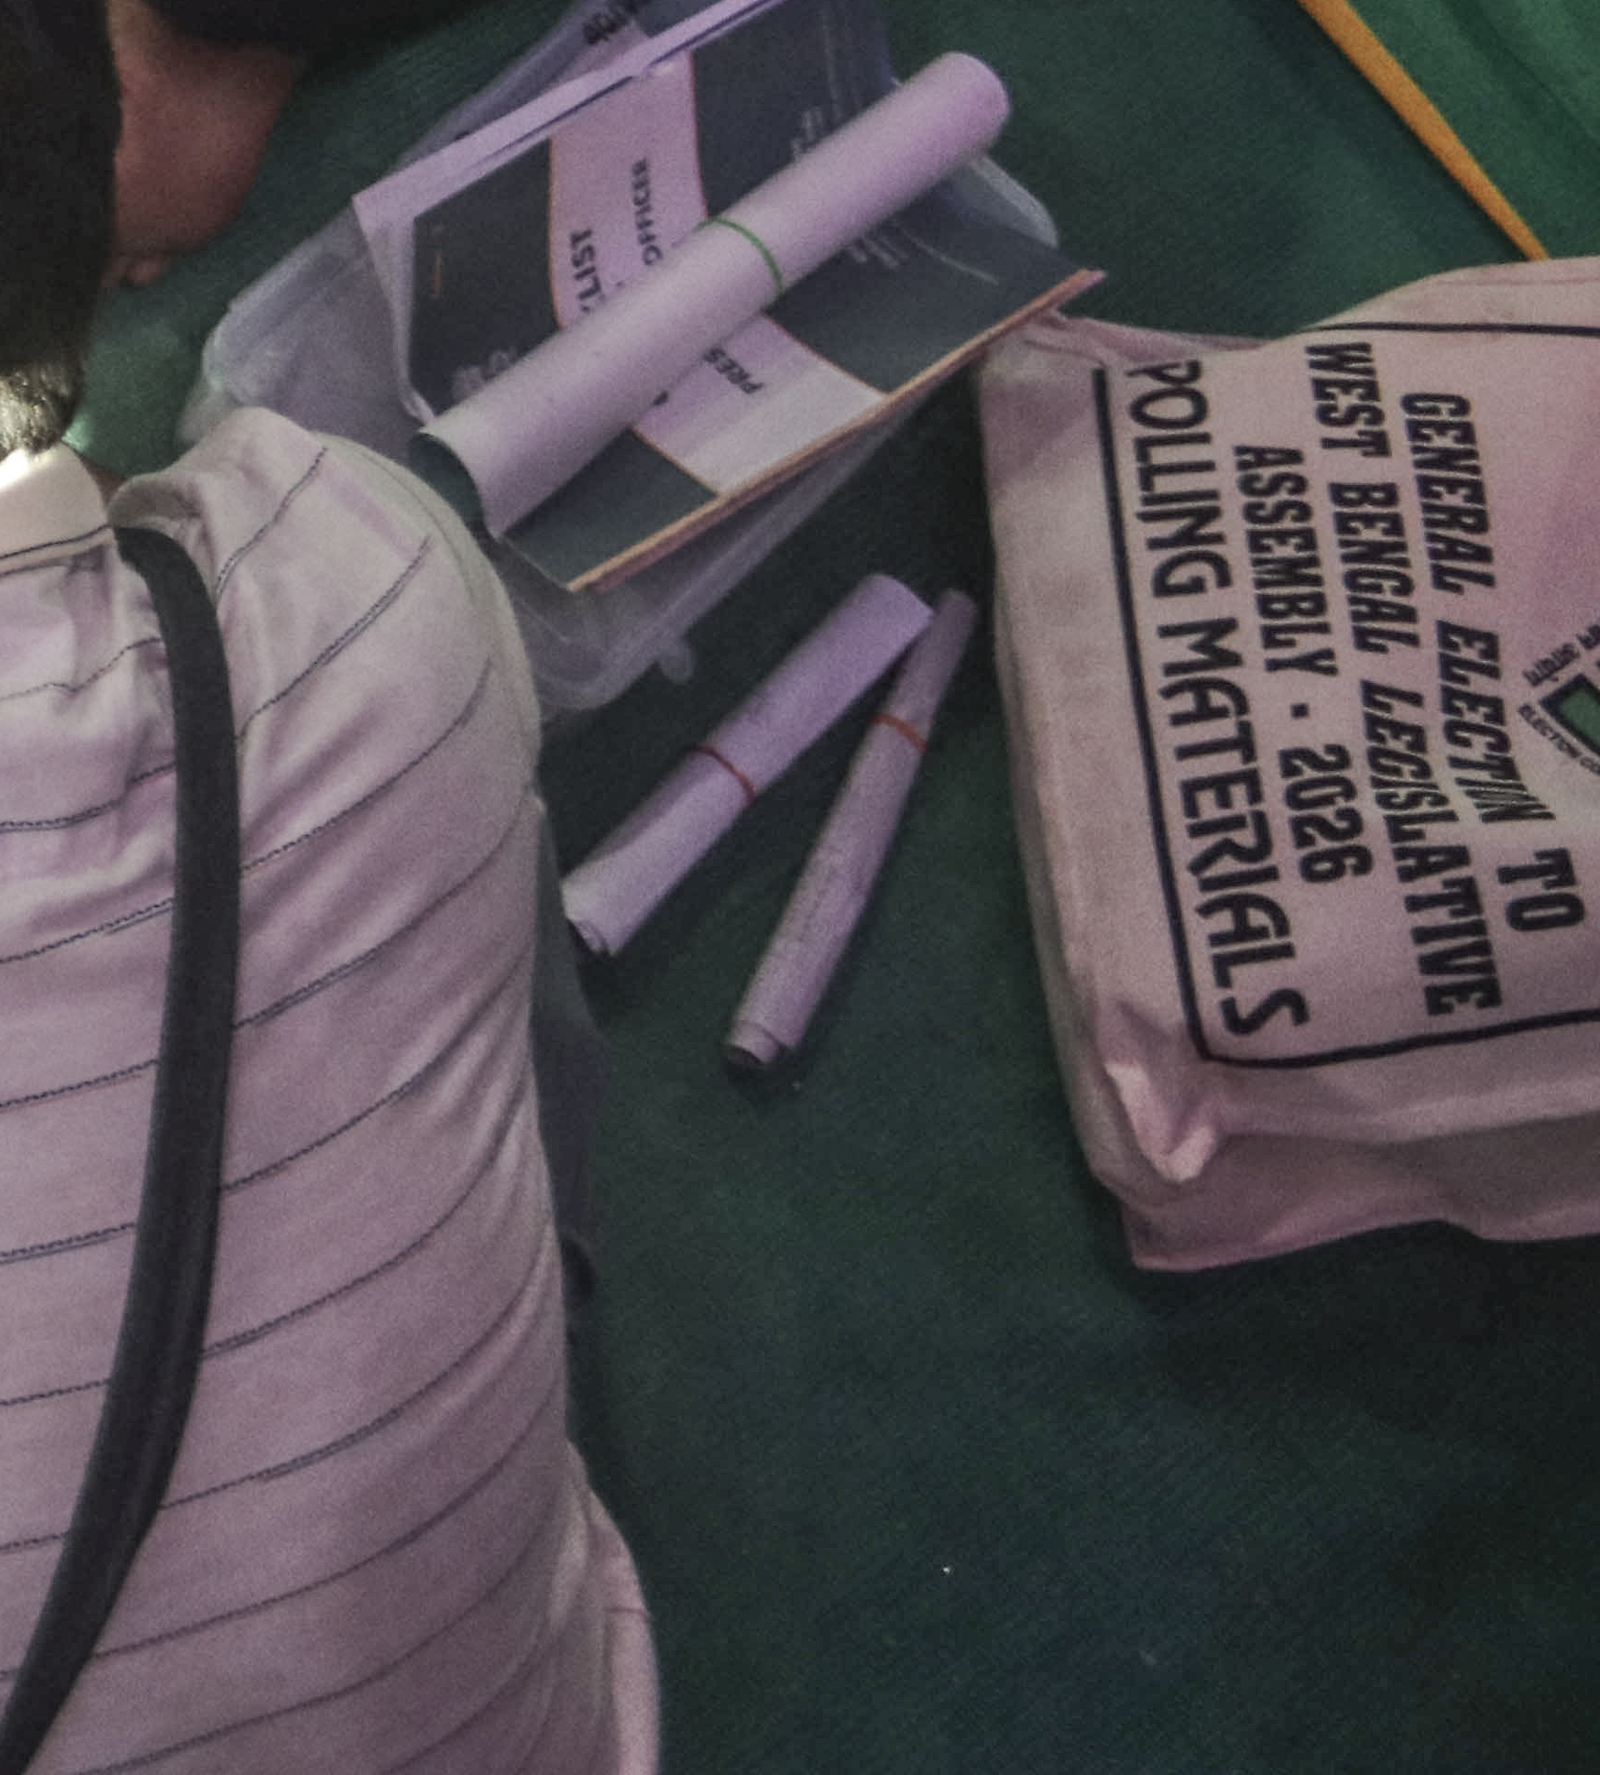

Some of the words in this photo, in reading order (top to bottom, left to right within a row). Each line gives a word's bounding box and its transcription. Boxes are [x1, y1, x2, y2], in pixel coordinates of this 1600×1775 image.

[571, 230, 603, 312] LIST
[1124, 359, 1232, 599] POLLING
[1305, 342, 1392, 458] WEST
[1233, 445, 1338, 676] ASSEMBLY
[1328, 482, 1420, 654] BENGAL
[1401, 393, 1495, 595] GENERAL
[1497, 848, 1586, 932] TO
[1157, 617, 1311, 1036] MATERIALS
[1278, 744, 1374, 884] 2026
[1360, 680, 1502, 1017] LEGISLATIVE
